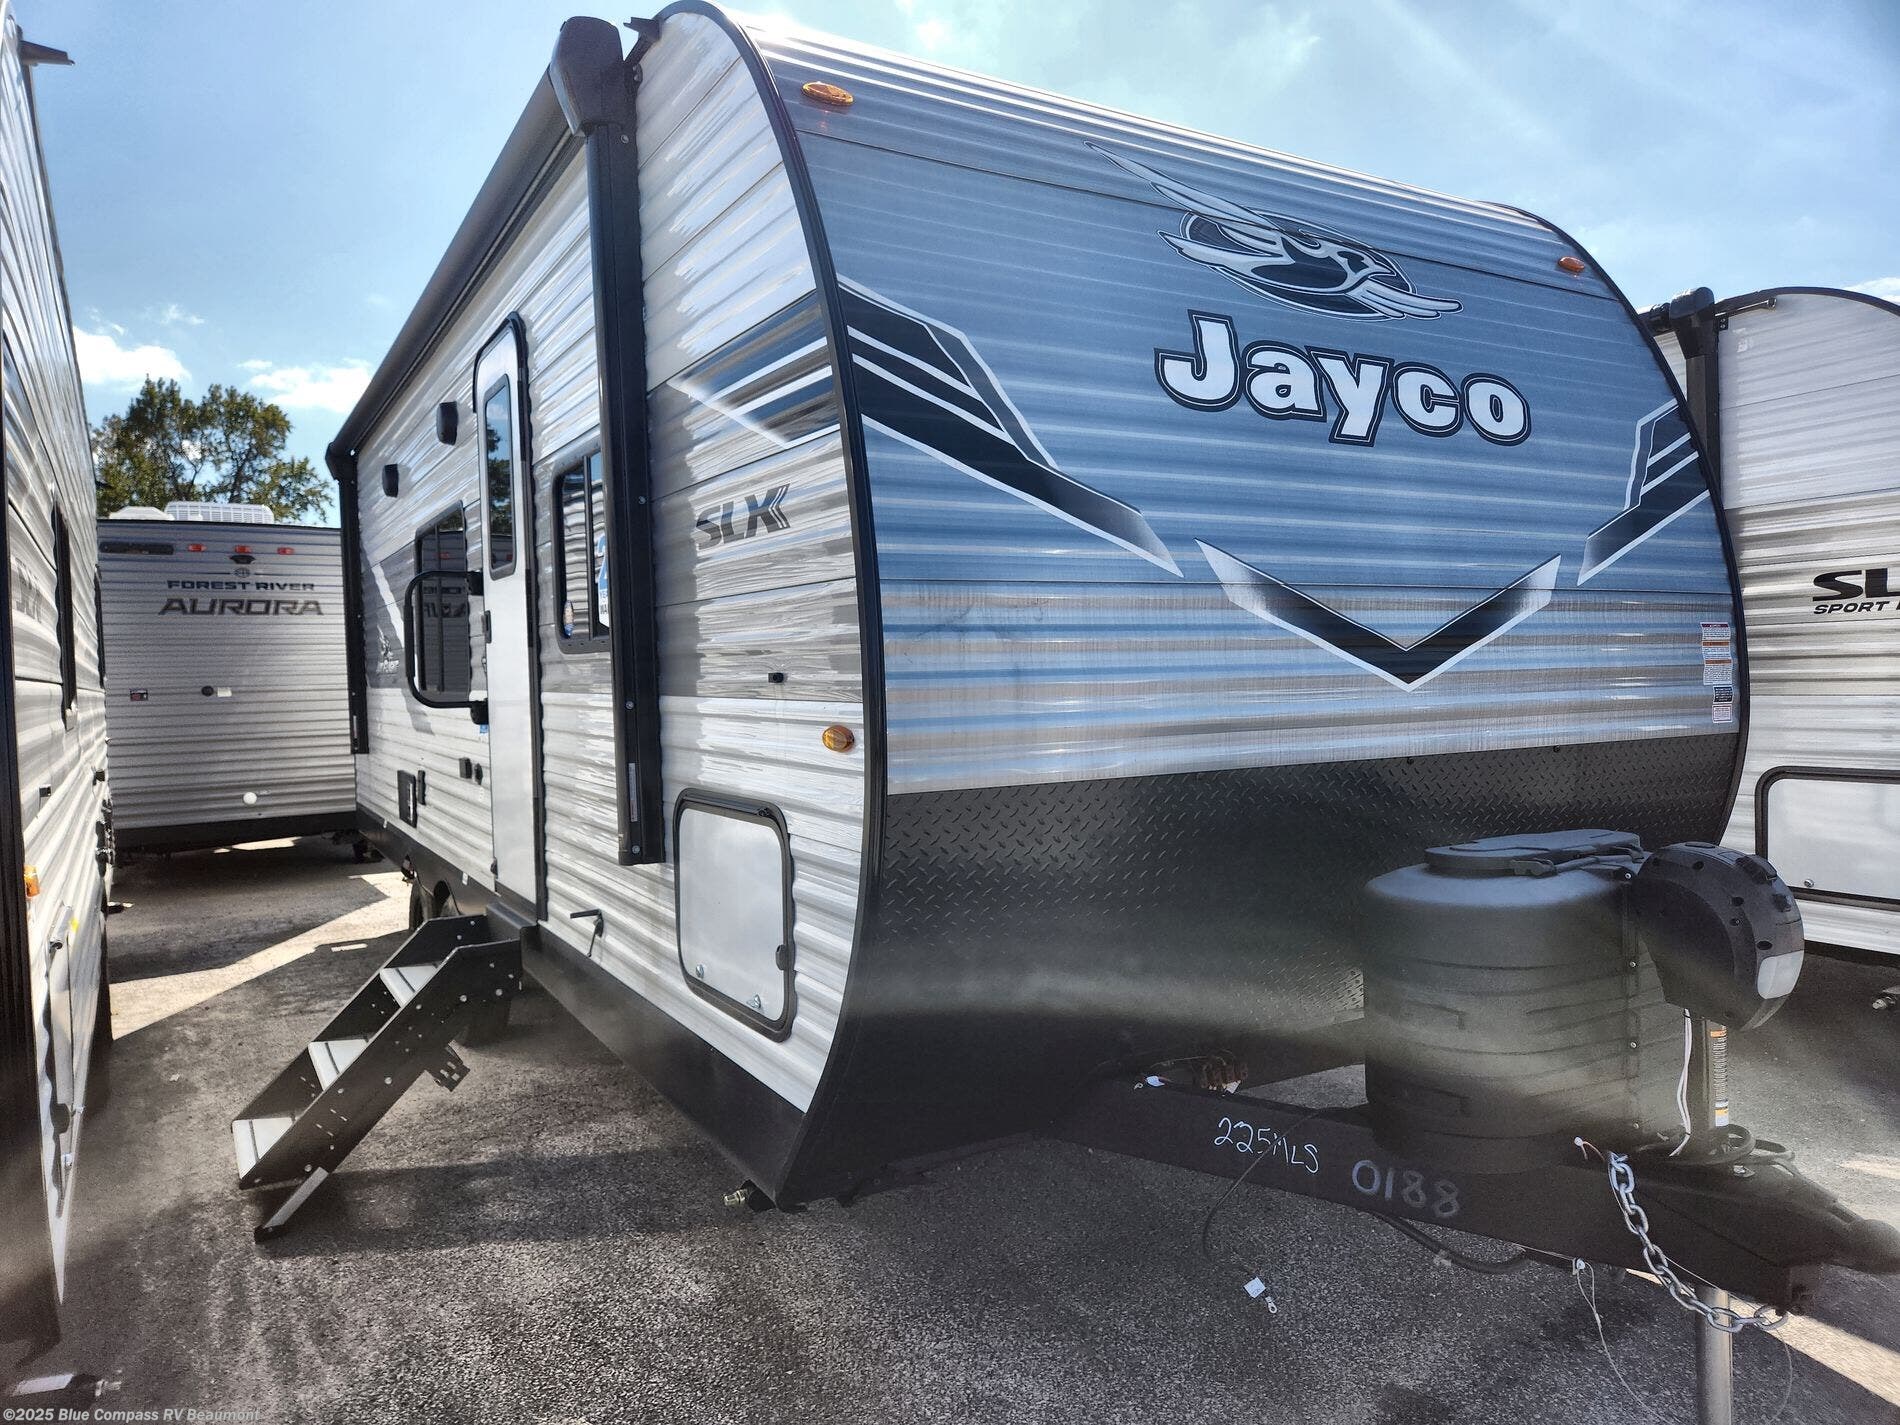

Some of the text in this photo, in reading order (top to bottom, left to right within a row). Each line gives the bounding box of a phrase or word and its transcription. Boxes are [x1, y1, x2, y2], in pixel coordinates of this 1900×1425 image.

[1154, 309, 1531, 447] Jayco
[167, 580, 315, 591] FOREST RIVER
[158, 598, 324, 616] AURORA
[1814, 601, 1890, 614] SPORT
[1351, 1159, 1460, 1218] 0188
